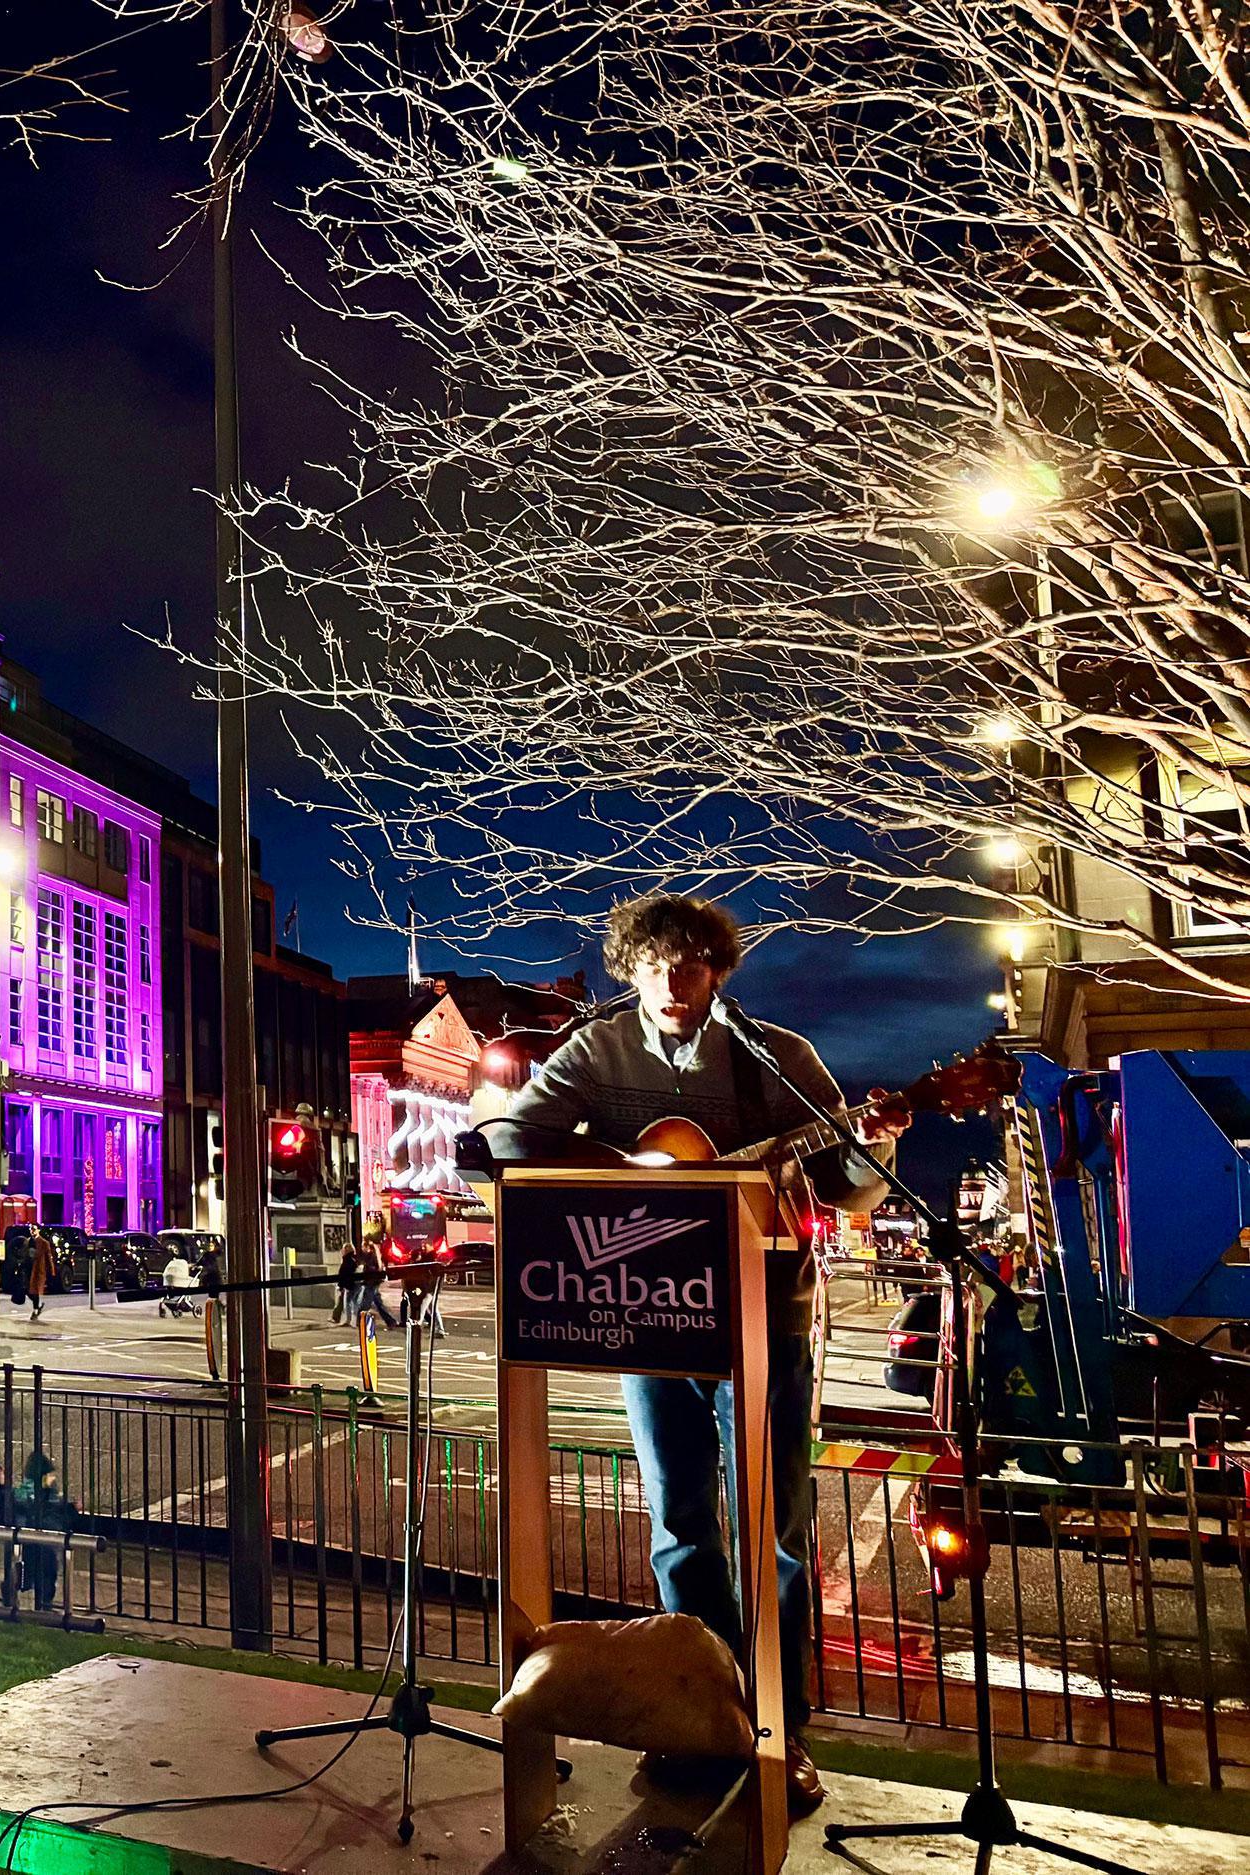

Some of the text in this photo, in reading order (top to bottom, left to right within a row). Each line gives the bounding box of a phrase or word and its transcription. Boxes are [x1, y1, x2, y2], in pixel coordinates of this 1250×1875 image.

[519, 1260, 715, 1309] Chabad
[518, 1319, 635, 1349] Edinburgh
[589, 1307, 717, 1332] on Campus
